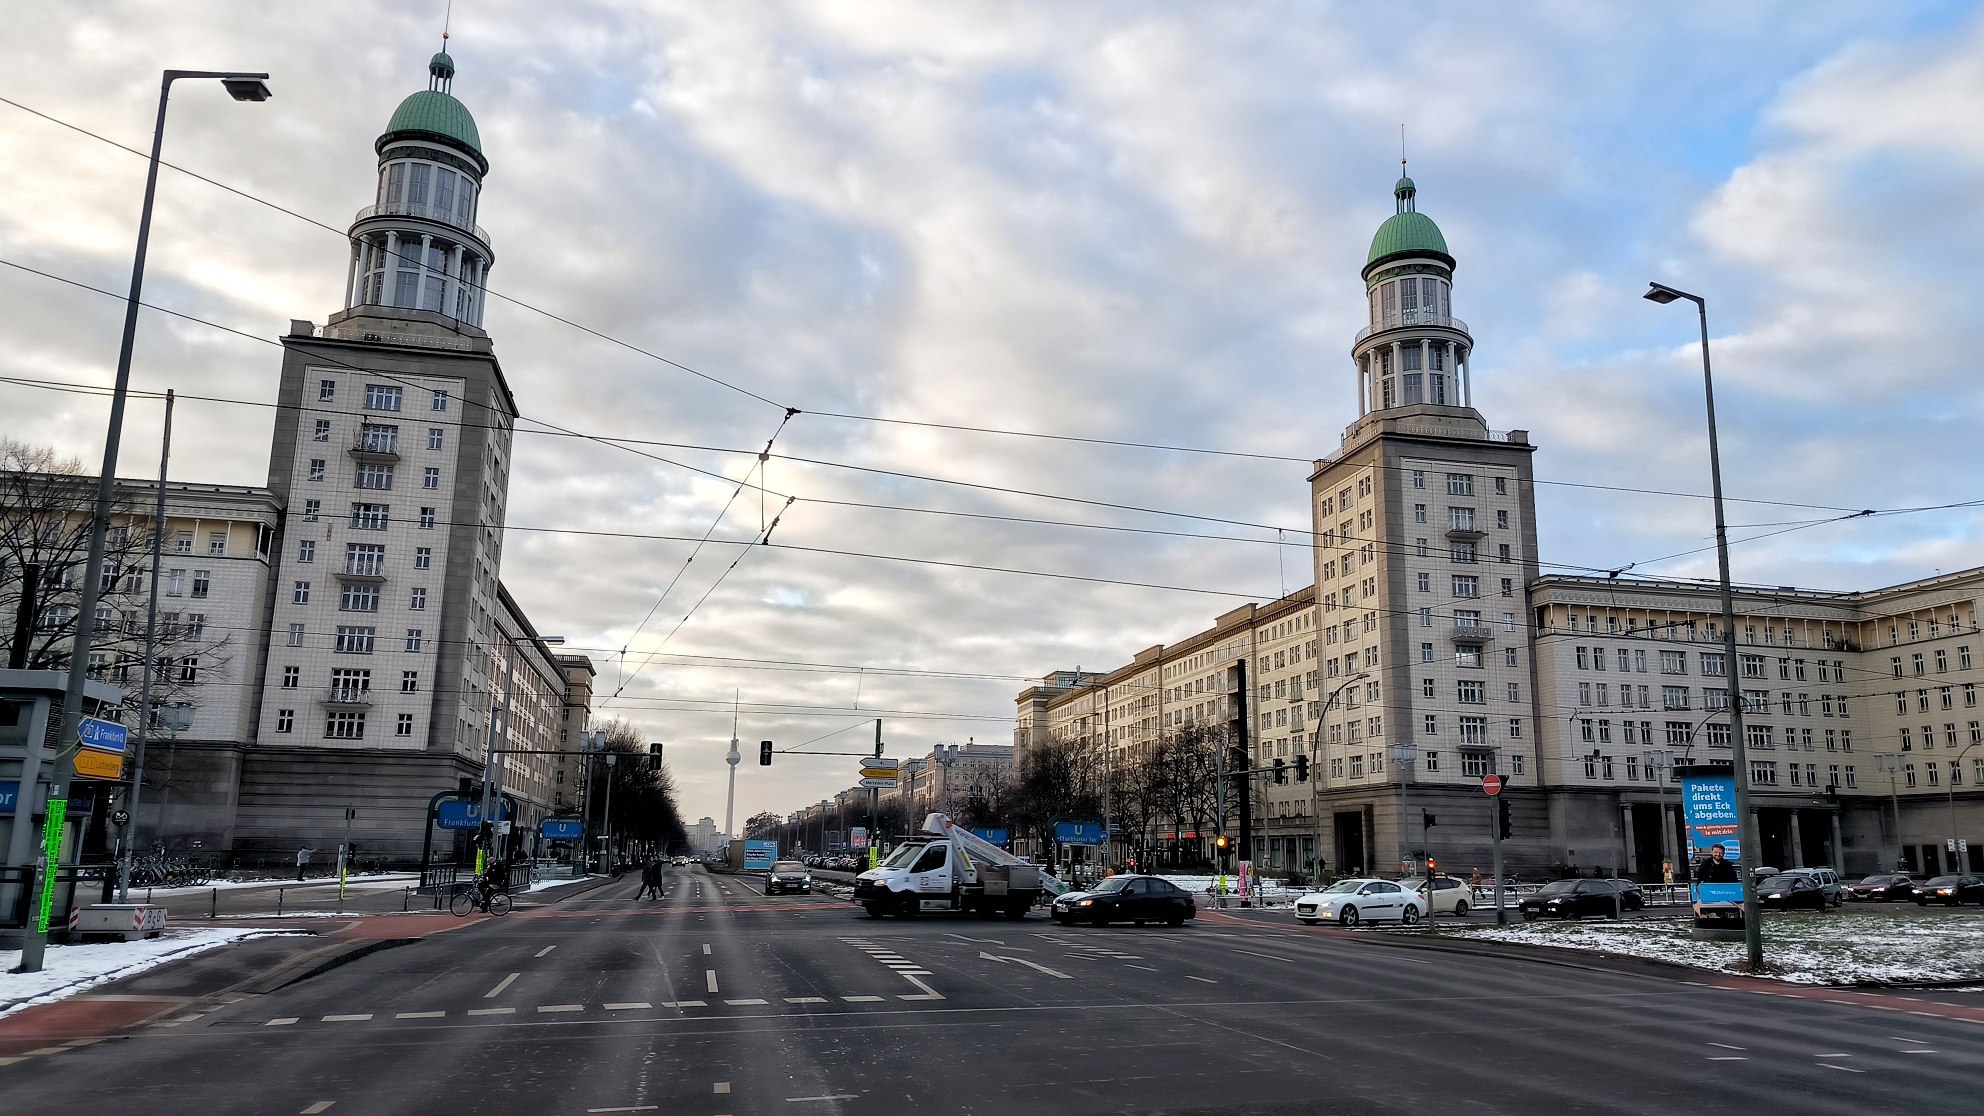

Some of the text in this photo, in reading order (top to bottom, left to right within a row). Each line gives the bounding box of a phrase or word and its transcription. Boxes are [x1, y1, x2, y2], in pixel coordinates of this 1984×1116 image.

[1691, 784, 1724, 792] Pakete
[1692, 793, 1721, 801] direkt
[1715, 802, 1731, 810] Eck
[1695, 811, 1736, 820] abgeben.
[444, 818, 481, 827] Frankfurte
[559, 823, 566, 832] U
[1074, 824, 1083, 835] U
[986, 830, 994, 839] U
